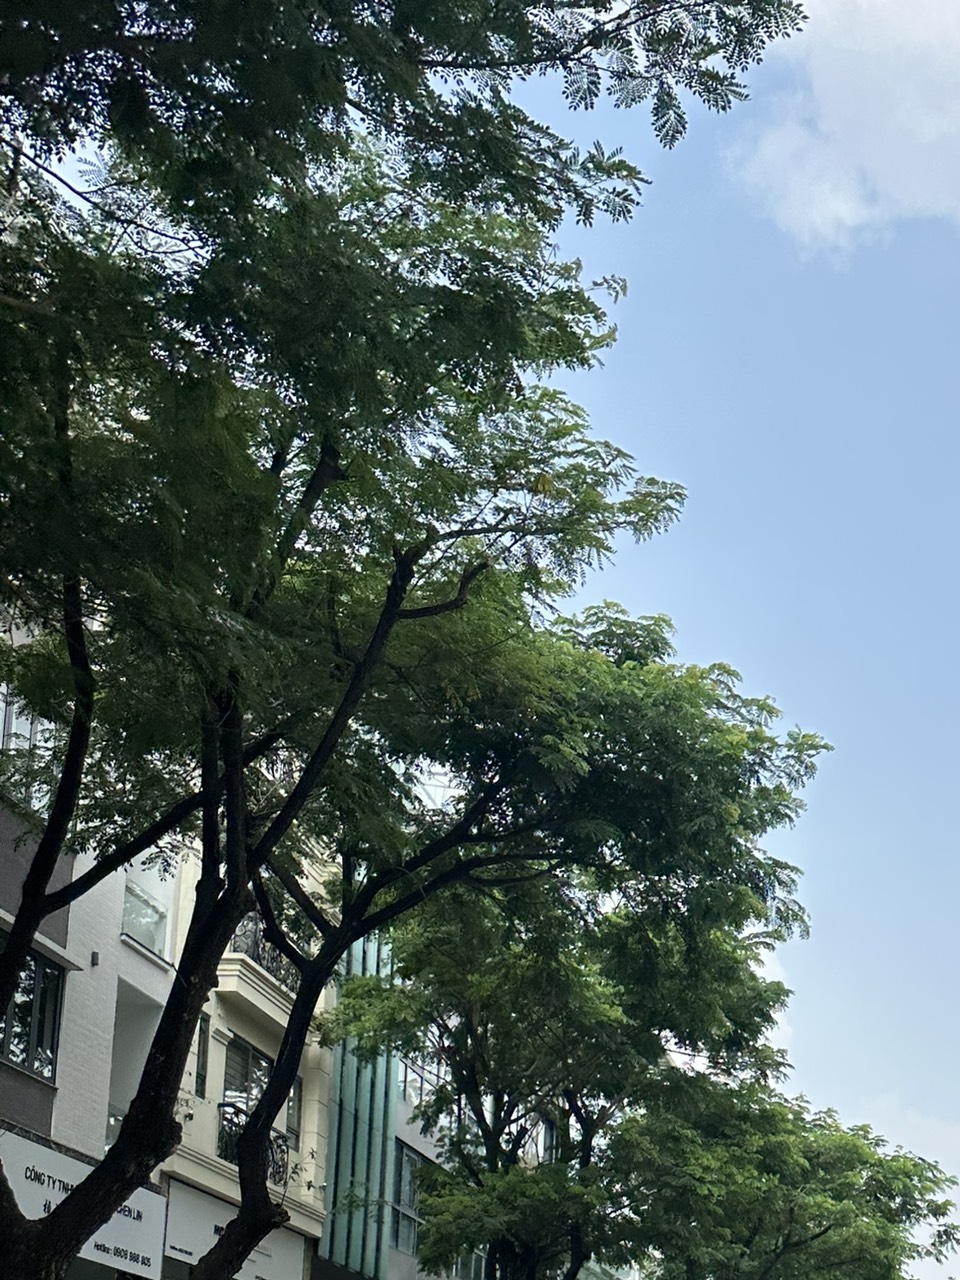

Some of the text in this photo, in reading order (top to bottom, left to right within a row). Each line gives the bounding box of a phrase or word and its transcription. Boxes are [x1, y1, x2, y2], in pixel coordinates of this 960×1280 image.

[25, 1165, 75, 1194] CÔNG TY TNH
